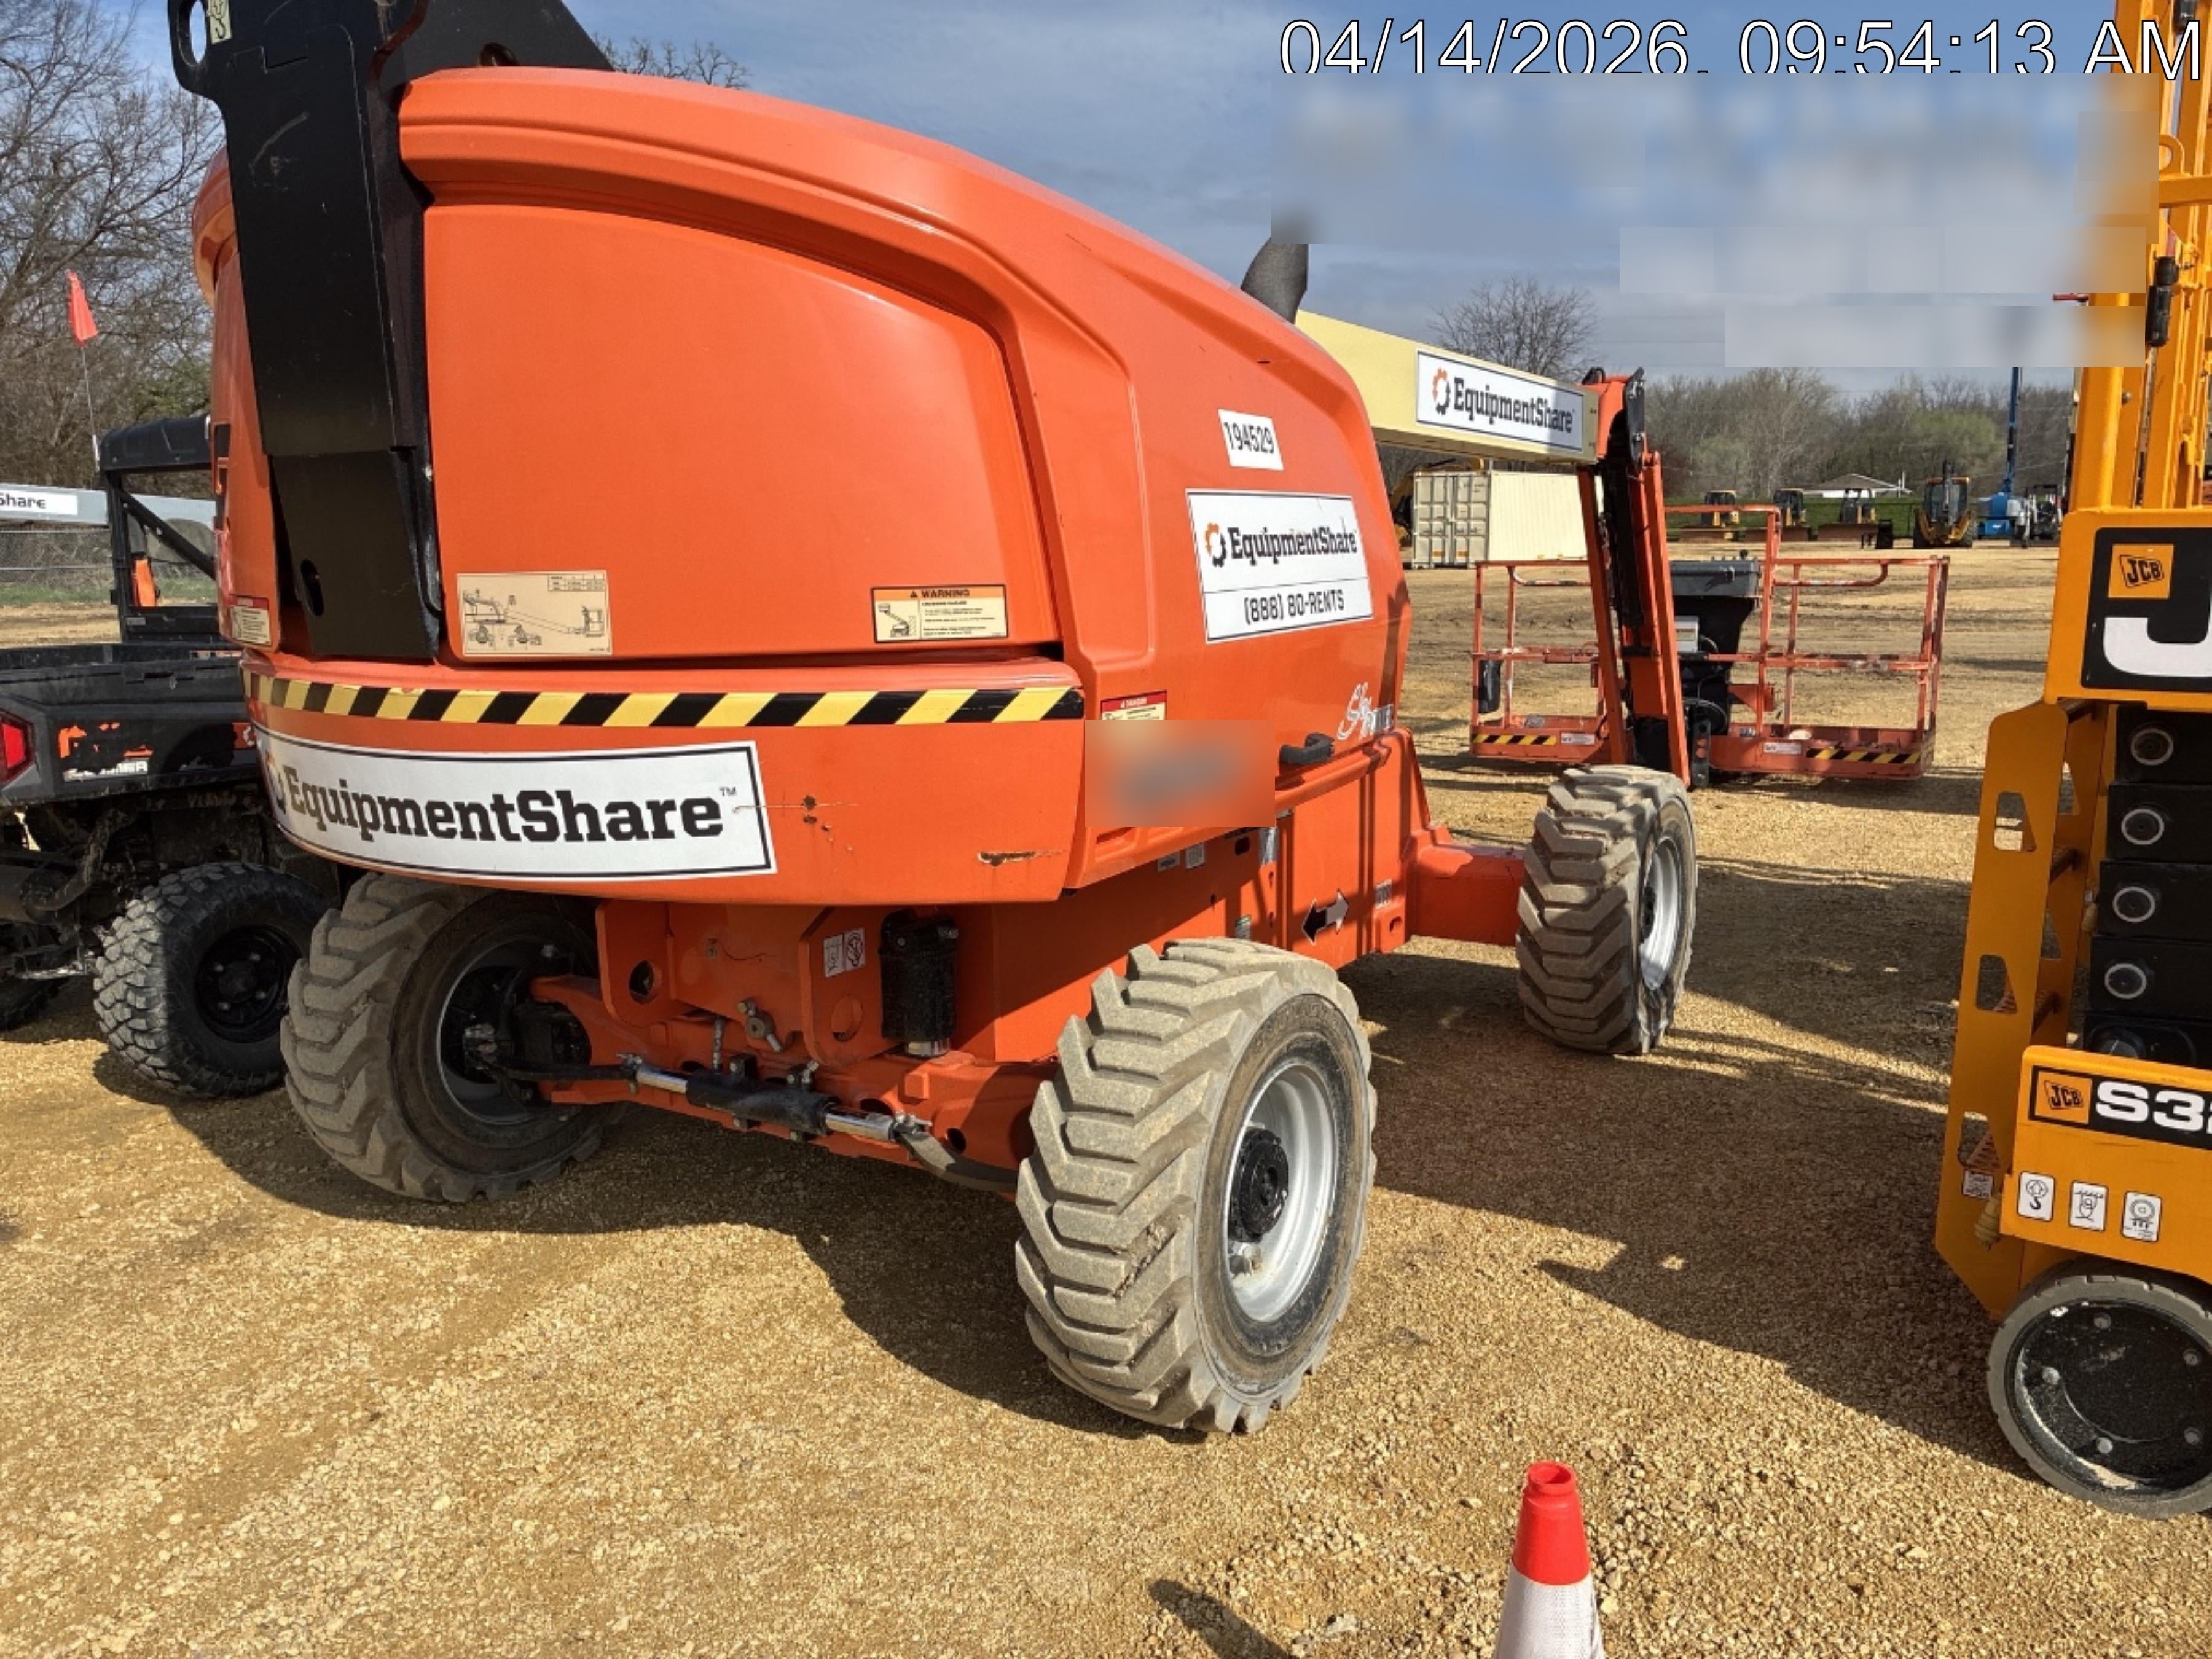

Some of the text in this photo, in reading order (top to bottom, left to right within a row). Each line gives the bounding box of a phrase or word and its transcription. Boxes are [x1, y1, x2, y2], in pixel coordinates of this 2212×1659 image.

[1454, 377, 1573, 434] EquipmentShare
[1223, 422, 1274, 454] 194529
[1227, 527, 1357, 566] EquipmentShare
[2126, 557, 2162, 584] JCB
[1244, 589, 1344, 624] (888) 80-RENTS
[283, 766, 723, 842] EquipmentShare
[2050, 1084, 2082, 1107] JCB
[2096, 1081, 2212, 1135] S3
